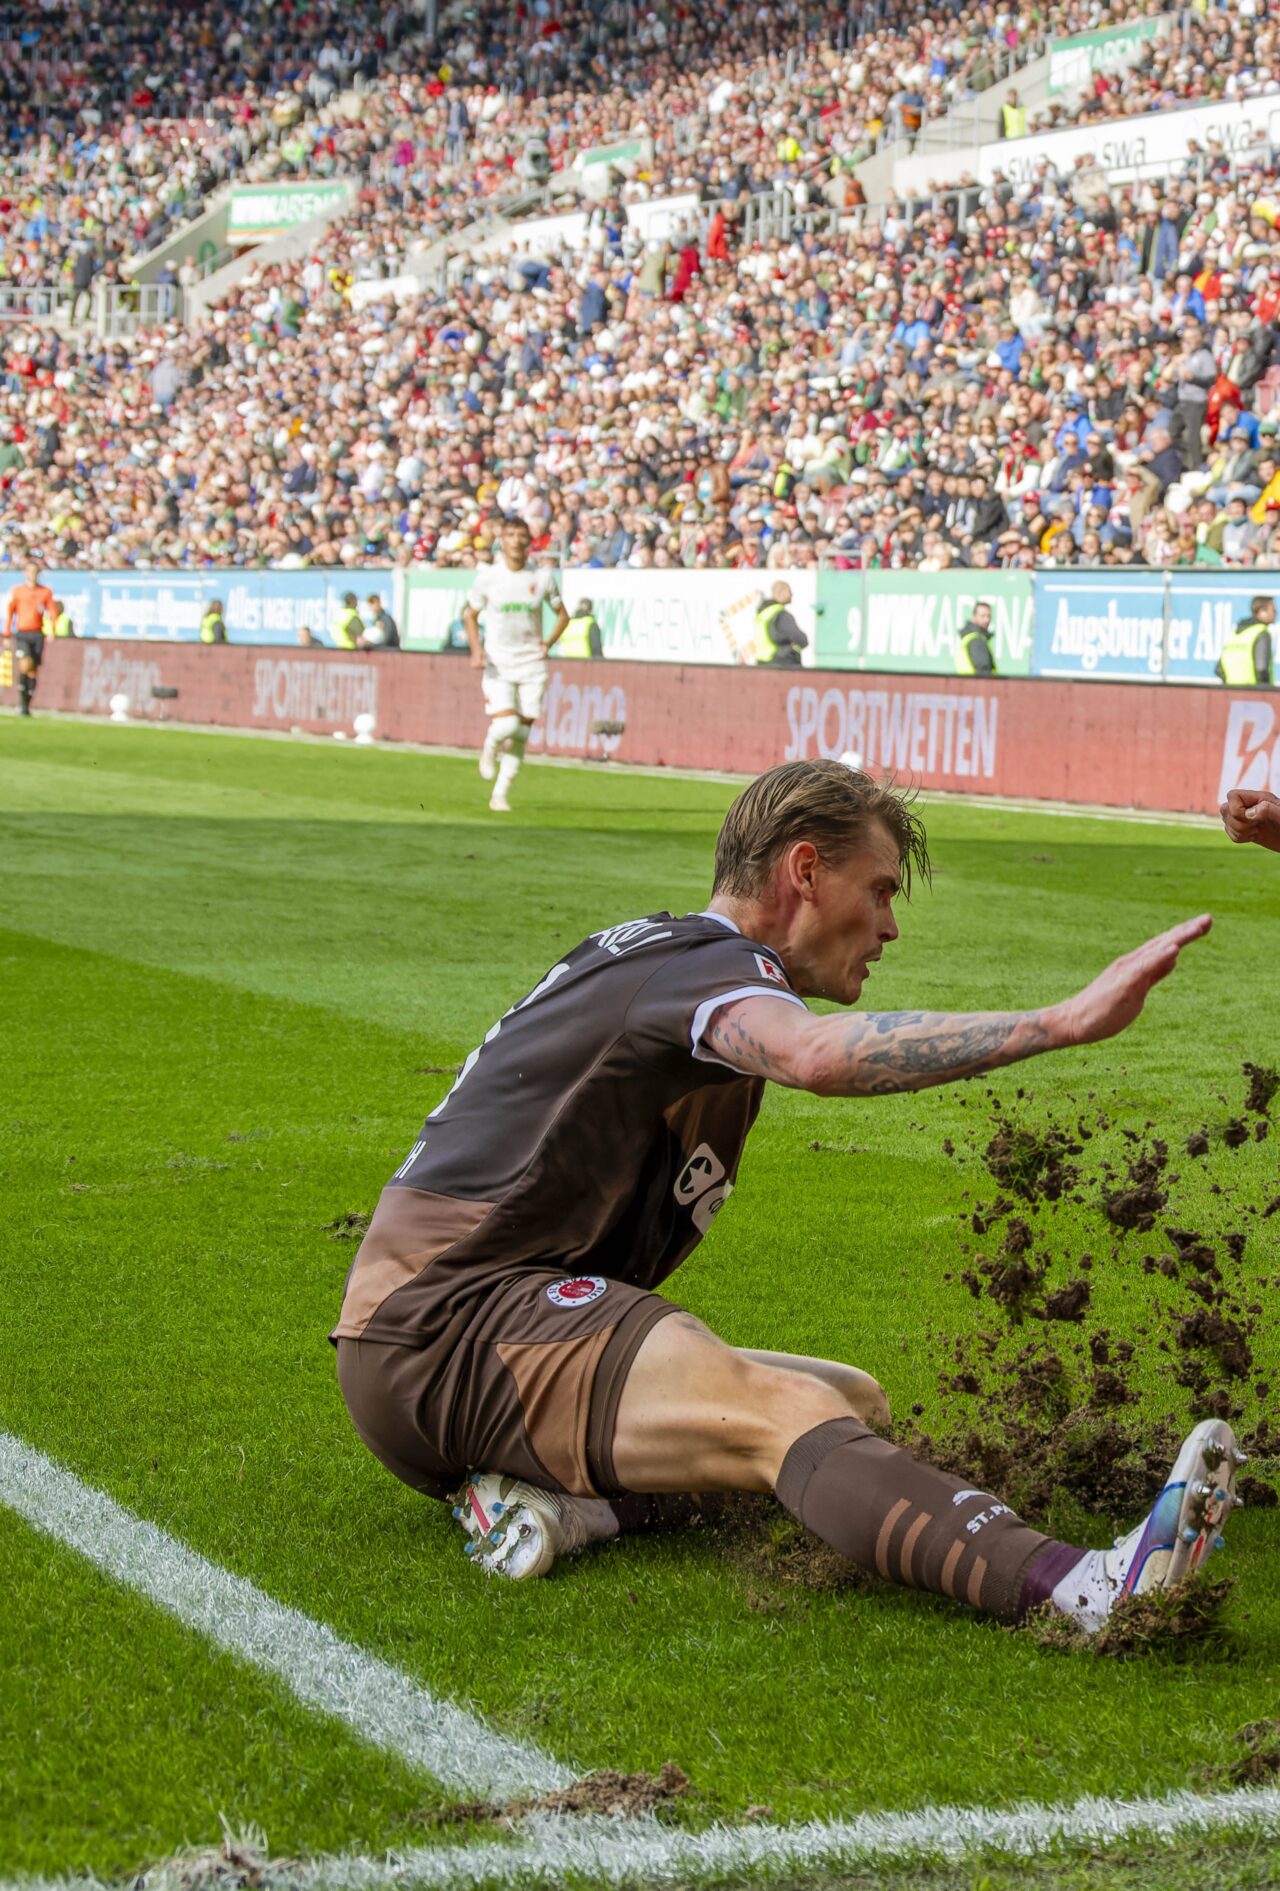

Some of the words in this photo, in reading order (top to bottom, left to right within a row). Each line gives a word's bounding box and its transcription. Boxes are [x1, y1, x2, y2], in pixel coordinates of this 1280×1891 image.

[1102, 136, 1146, 169] swa
[1050, 598, 1193, 673] Augsburger
[784, 686, 998, 778] SPORTWETTEN
